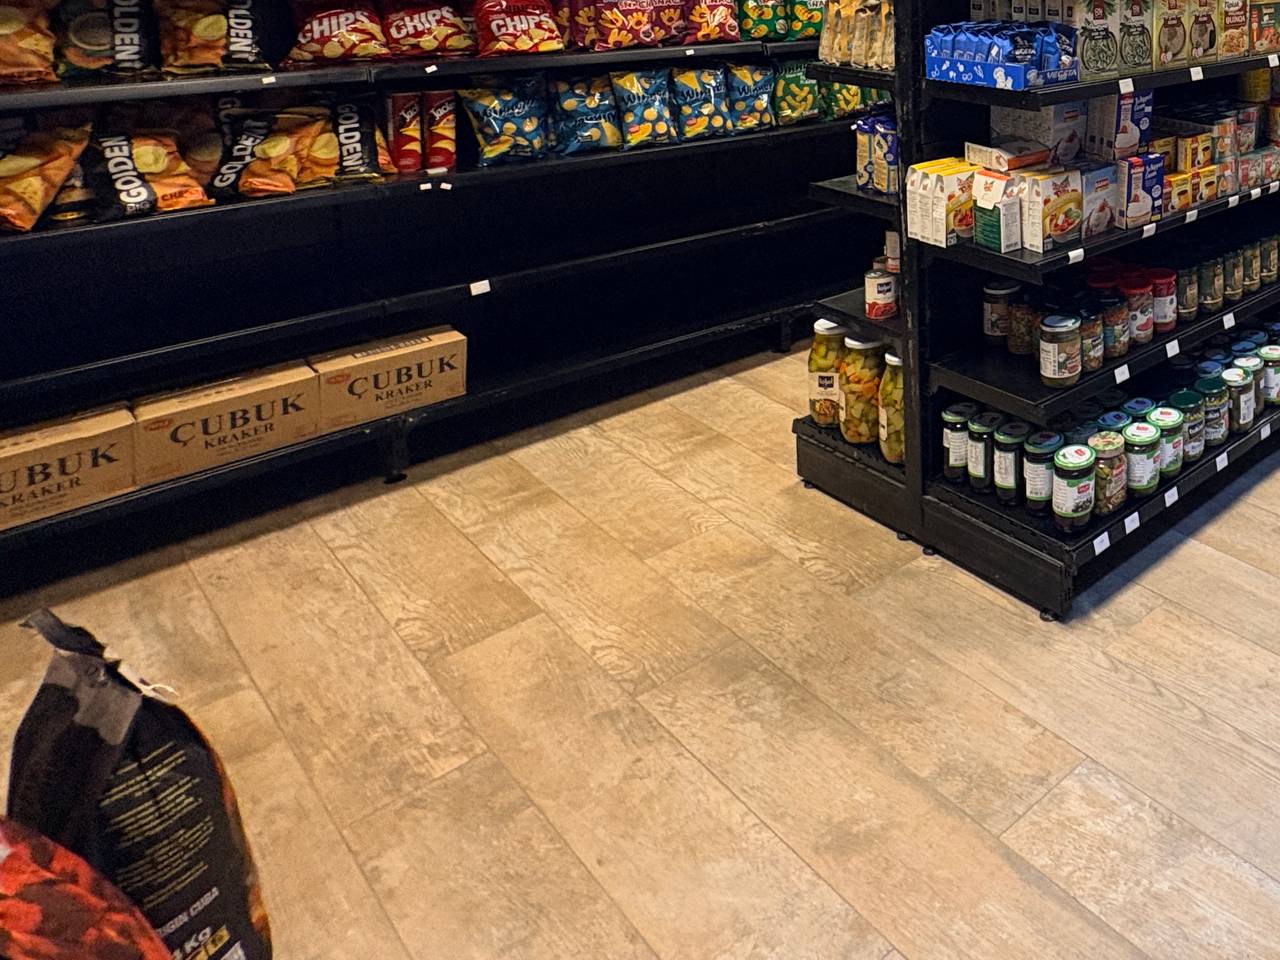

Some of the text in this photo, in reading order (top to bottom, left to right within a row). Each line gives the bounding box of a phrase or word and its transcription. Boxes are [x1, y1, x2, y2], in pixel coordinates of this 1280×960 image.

[297, 10, 372, 45] CHIPS
[390, 6, 454, 40] CHIPS
[489, 12, 555, 37] CHIPS
[346, 352, 459, 400] ÇUBUK
[374, 378, 435, 403] KRAKER
[168, 392, 306, 448] ÇUBUK
[203, 422, 276, 450] KRAKER
